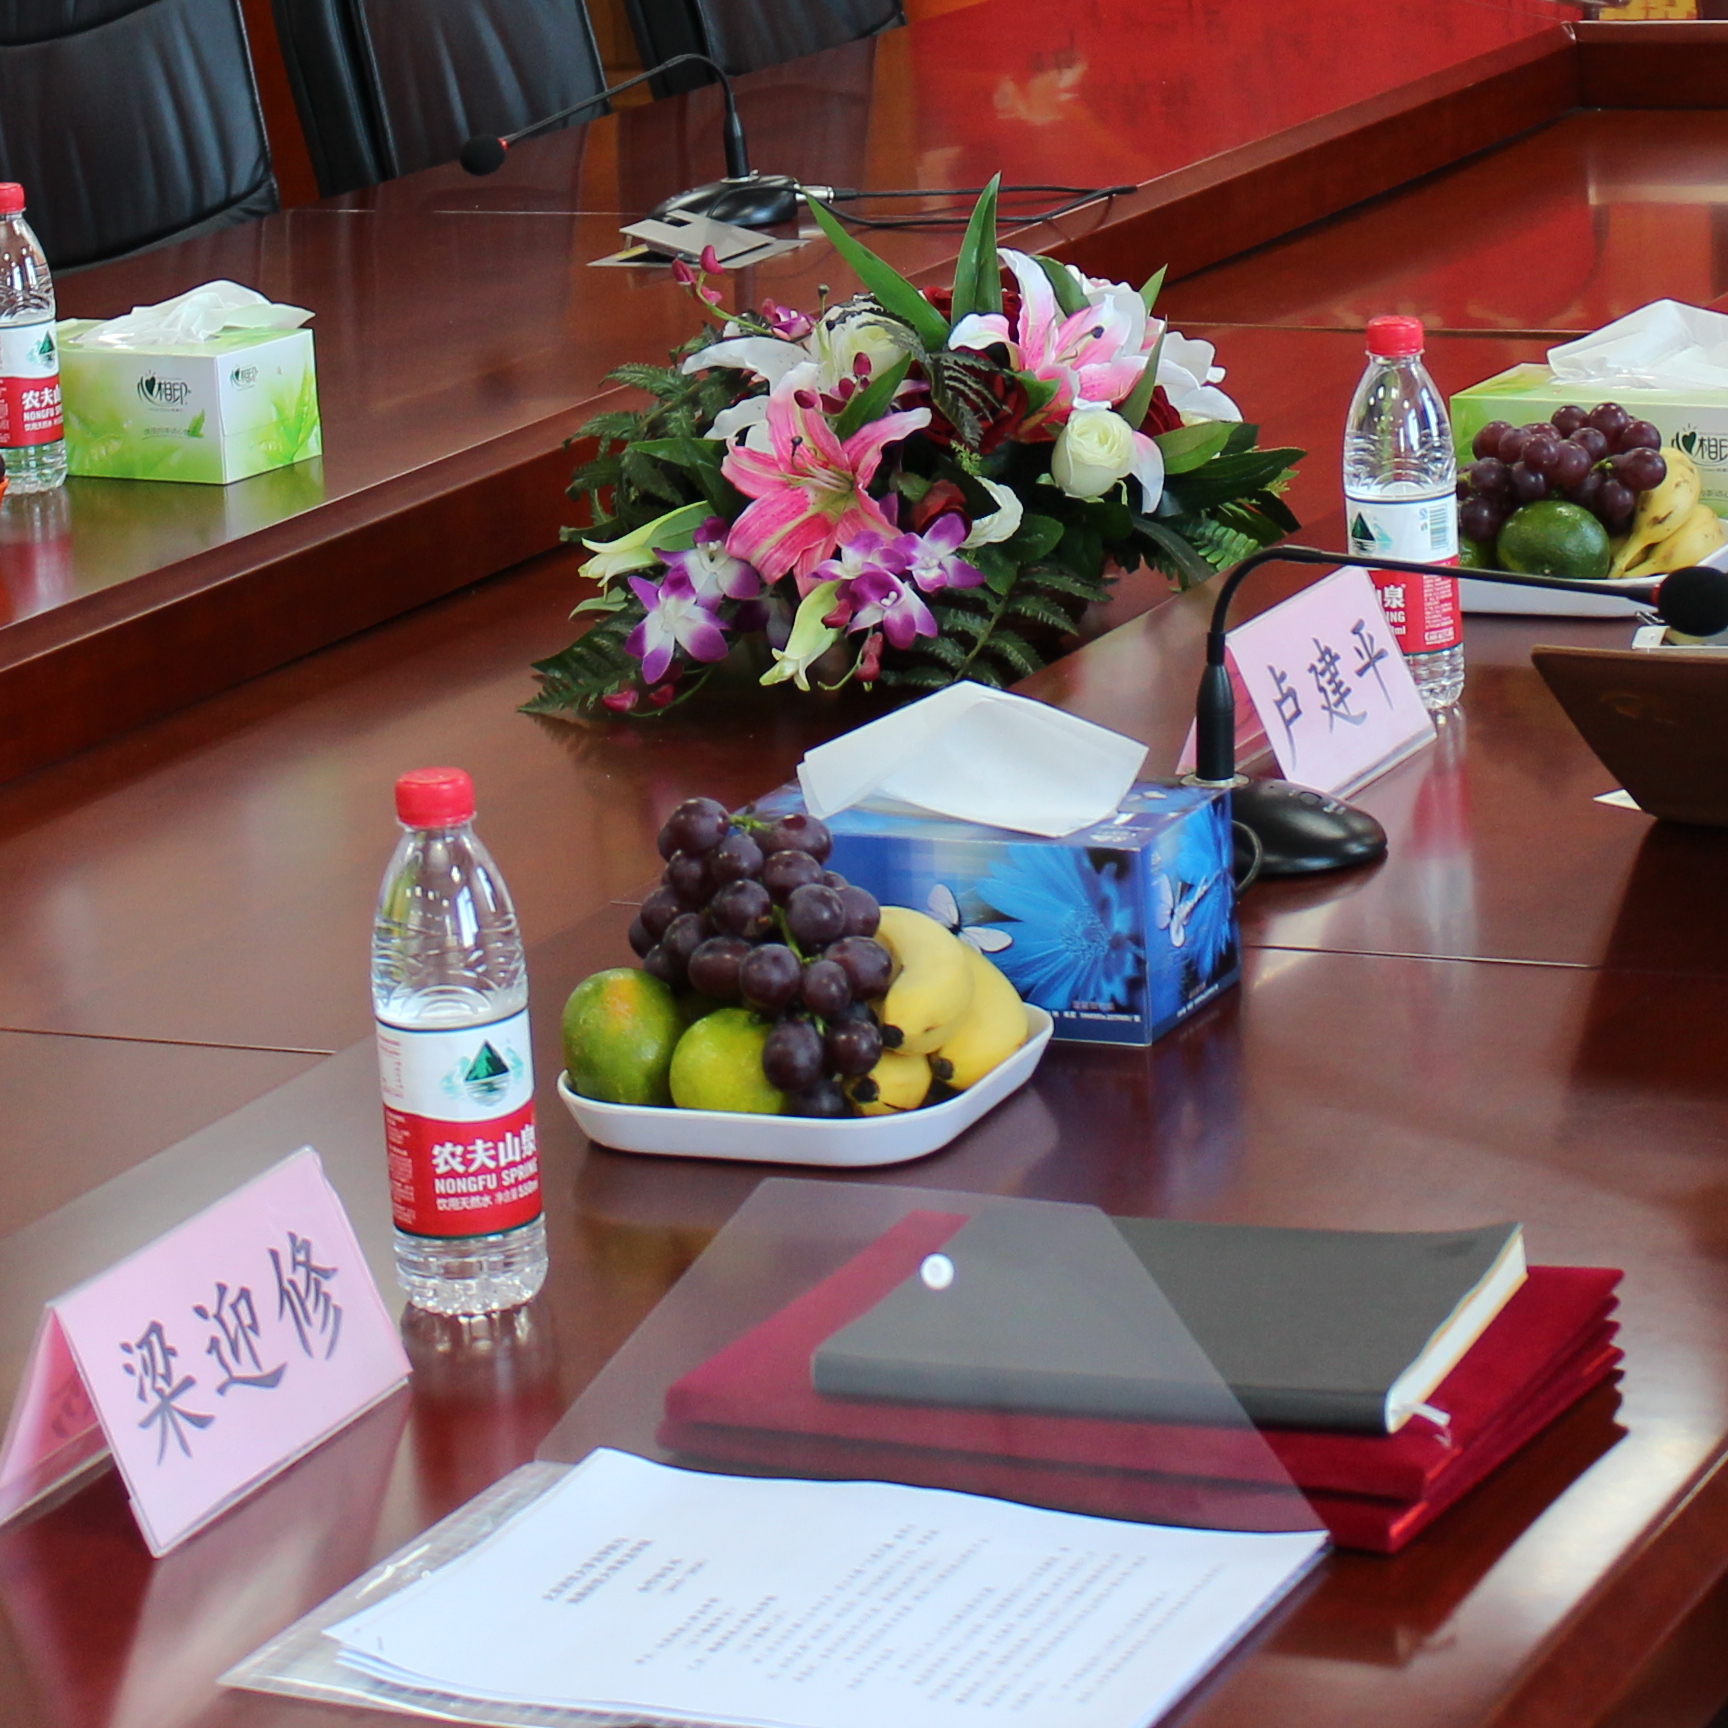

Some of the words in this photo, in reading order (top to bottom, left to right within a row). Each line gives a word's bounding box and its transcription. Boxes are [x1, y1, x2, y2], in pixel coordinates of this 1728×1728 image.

[1267, 618, 1394, 772] 卢建平
[431, 1123, 537, 1176] 农夫山泉
[434, 1172, 499, 1195] NONGFU
[436, 1193, 493, 1212] 饮用天然水
[119, 1230, 343, 1466] 梁迎修
